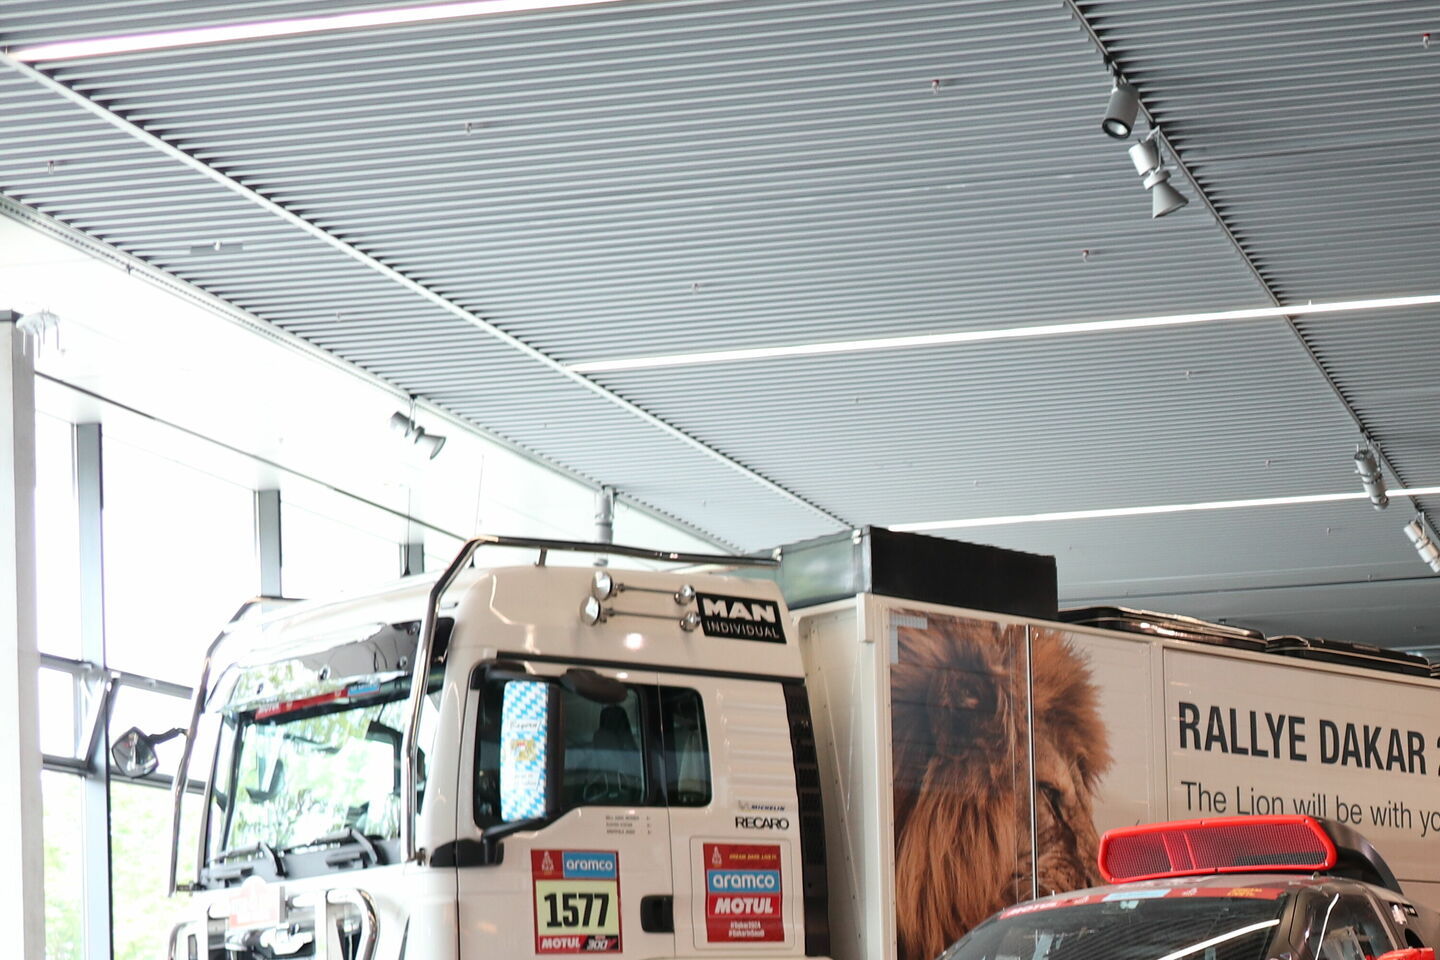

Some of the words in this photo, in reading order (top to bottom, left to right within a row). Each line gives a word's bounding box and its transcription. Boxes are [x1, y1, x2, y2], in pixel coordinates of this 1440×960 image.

[702, 598, 776, 623] MAN
[707, 620, 780, 639] INDIVIDUAL
[1178, 700, 1308, 762] RALLYE
[1319, 719, 1427, 776] DAKAR
[1181, 781, 1227, 814] The
[1236, 785, 1284, 816] Lion
[1293, 793, 1327, 818] will
[1336, 795, 1362, 824] be
[1370, 800, 1412, 829] with
[735, 816, 790, 831] RECARO
[566, 858, 613, 872] aramco
[713, 874, 775, 889] aramco
[544, 892, 609, 929] 1577
[715, 897, 773, 915] MOTUL
[541, 937, 581, 950] MOTUL
